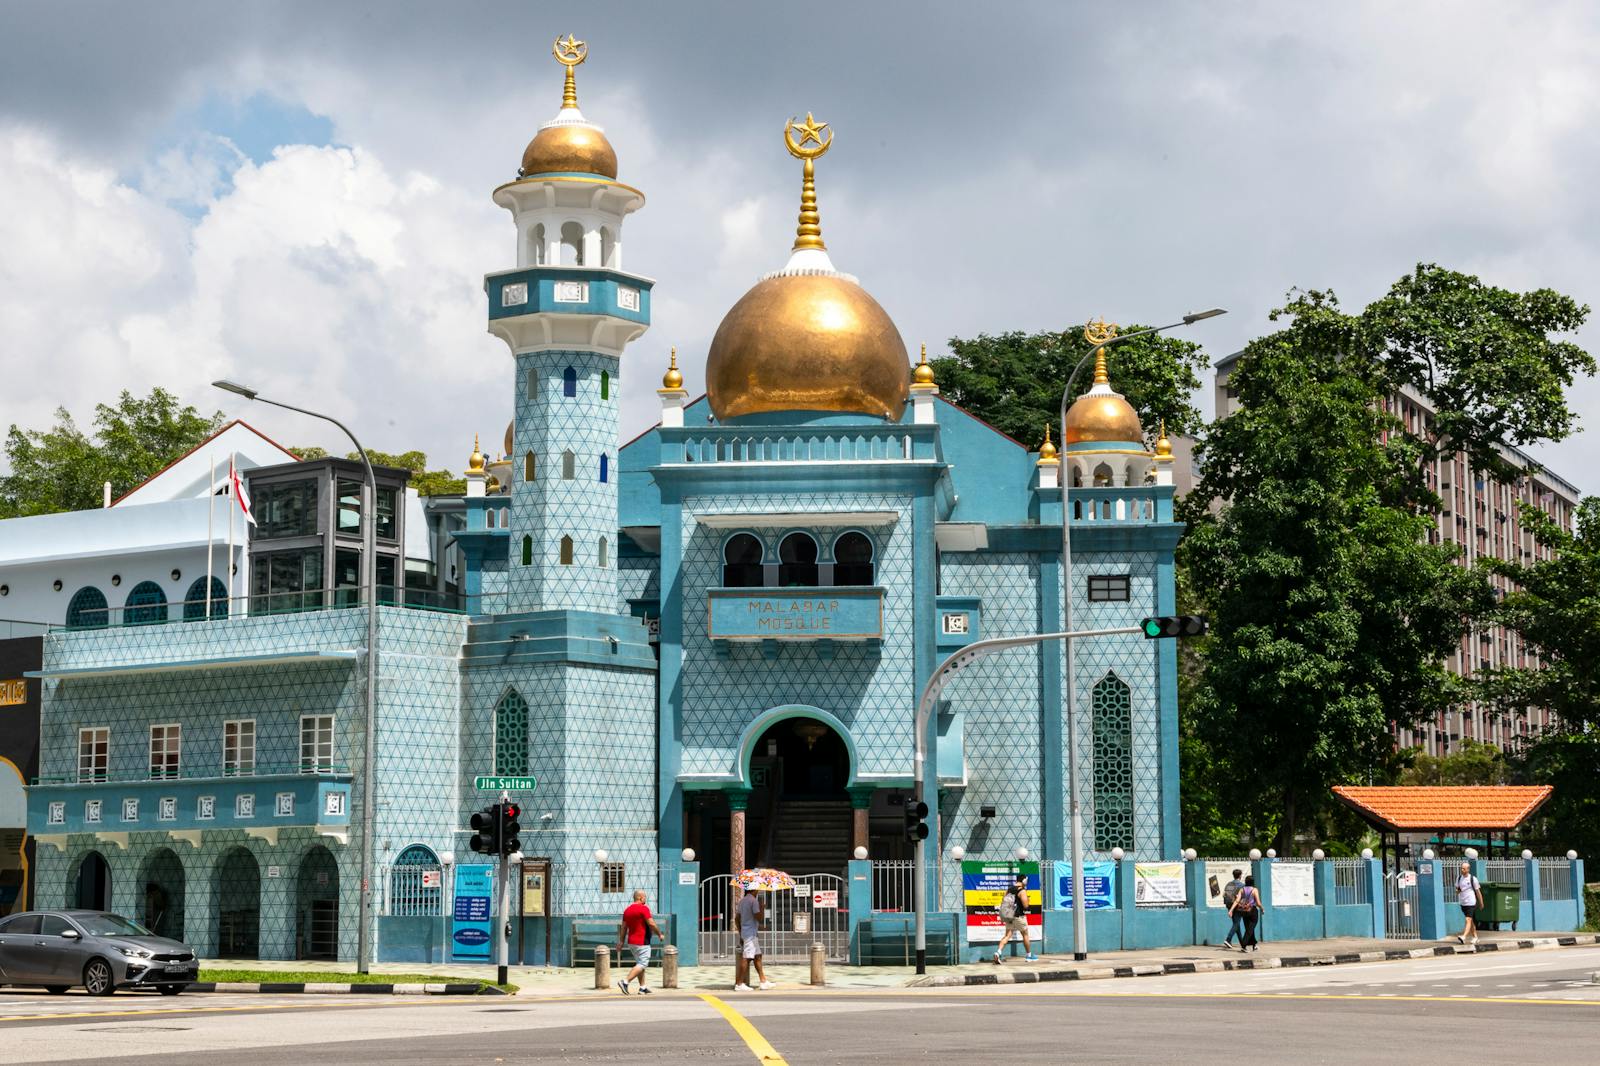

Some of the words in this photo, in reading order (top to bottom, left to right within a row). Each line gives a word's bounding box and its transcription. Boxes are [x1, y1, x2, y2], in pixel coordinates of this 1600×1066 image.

[749, 601, 839, 613] MALABAR
[759, 617, 832, 630] MOSQUE
[481, 778, 496, 789] Jln
[499, 778, 532, 789] Sultan
